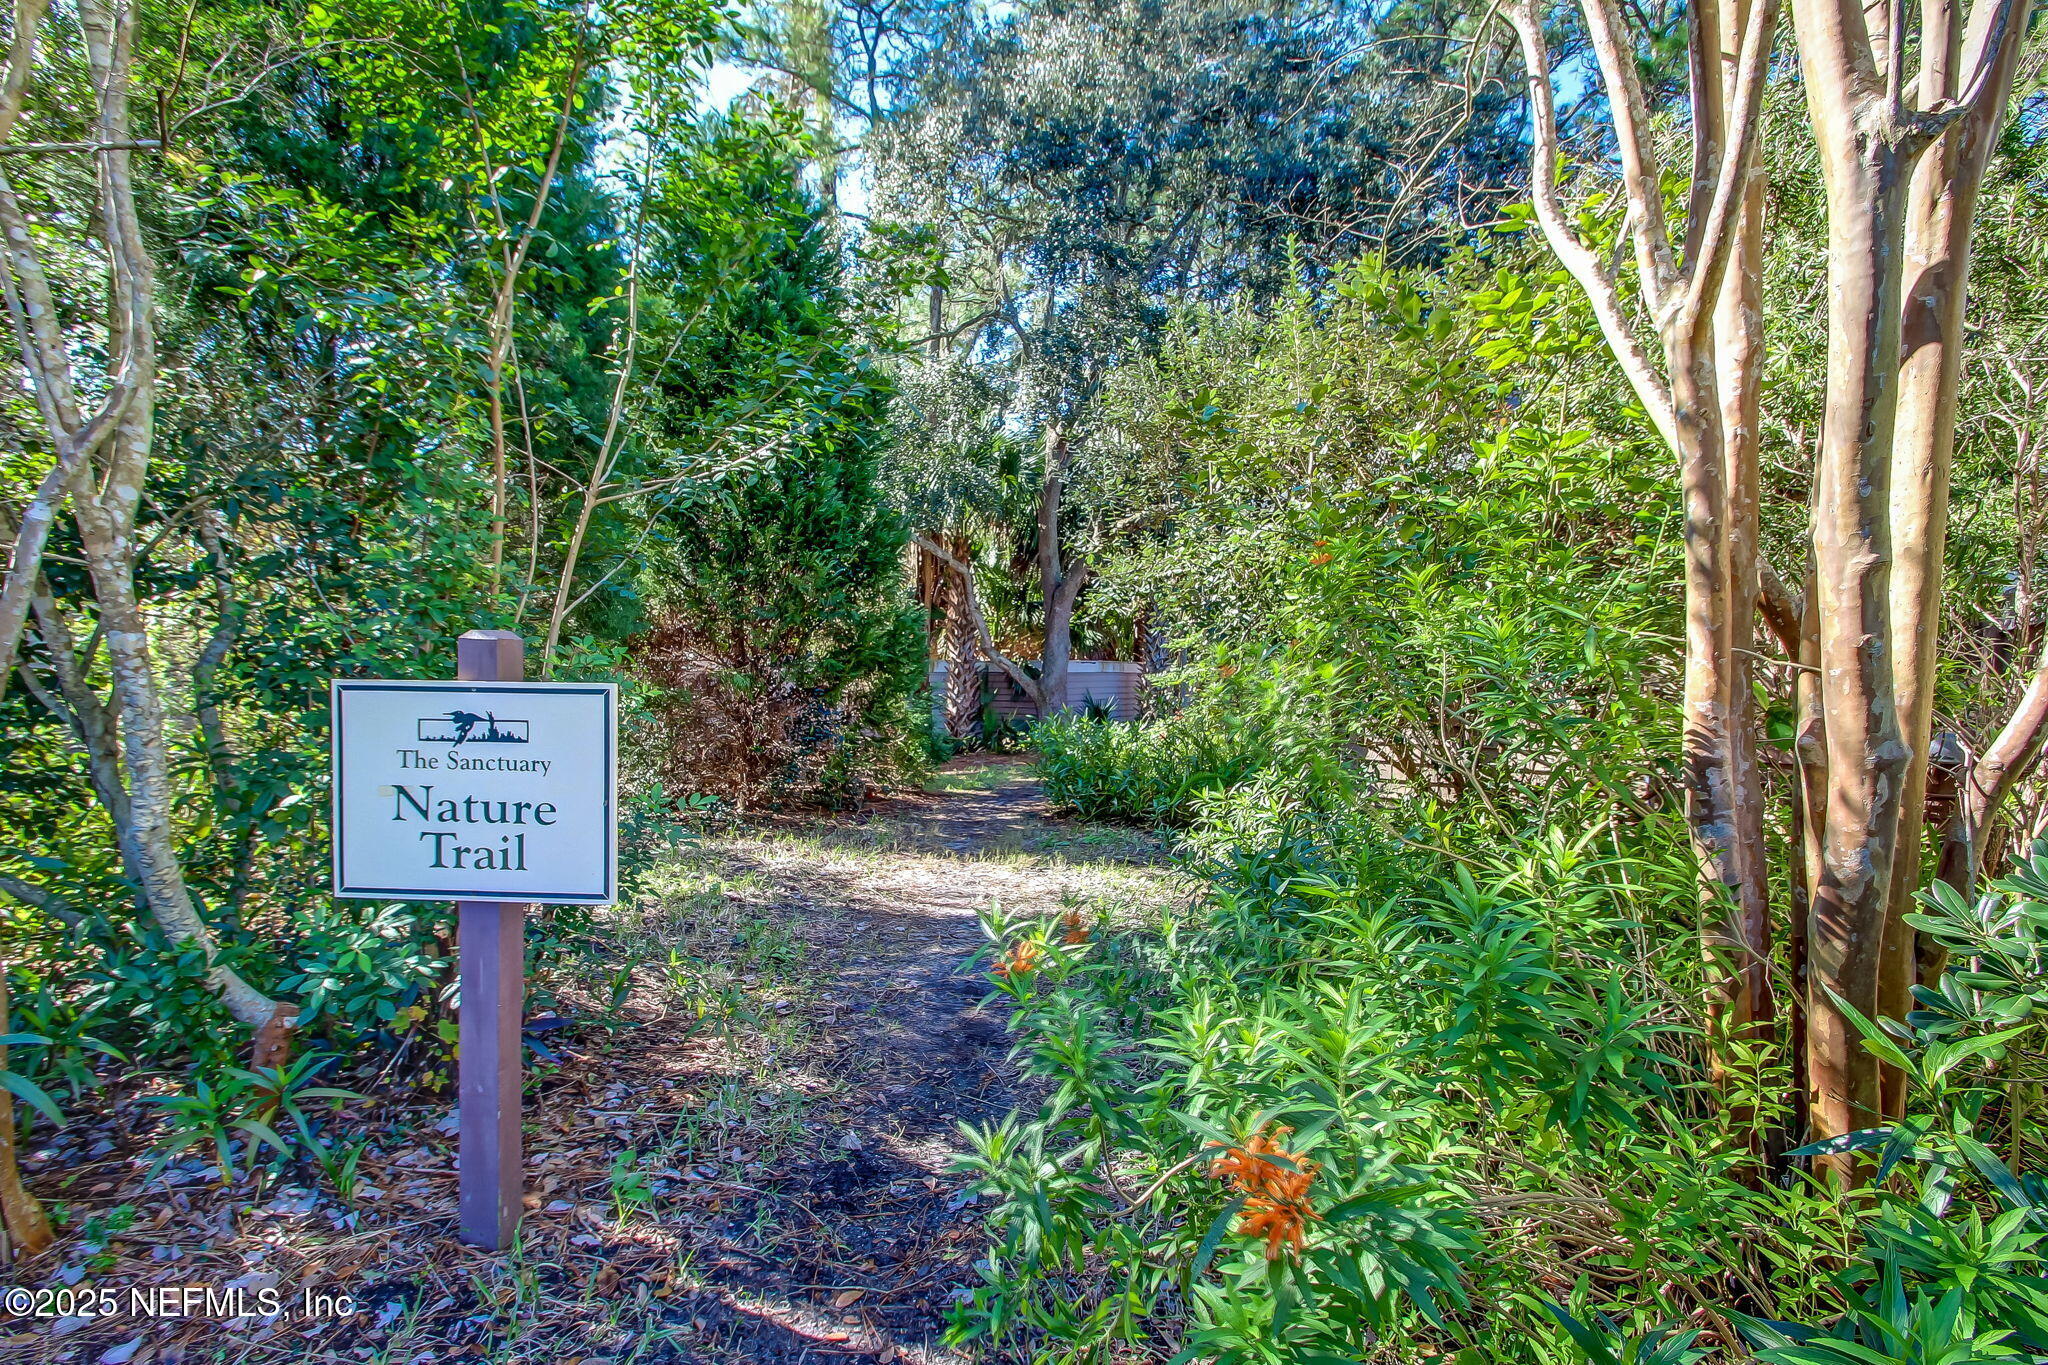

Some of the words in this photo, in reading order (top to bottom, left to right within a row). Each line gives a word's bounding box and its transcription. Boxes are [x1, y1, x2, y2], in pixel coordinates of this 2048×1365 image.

[396, 749, 439, 770] The
[447, 750, 552, 777] Sanctuary
[391, 784, 557, 826] Nature
[419, 831, 528, 871] Trail
